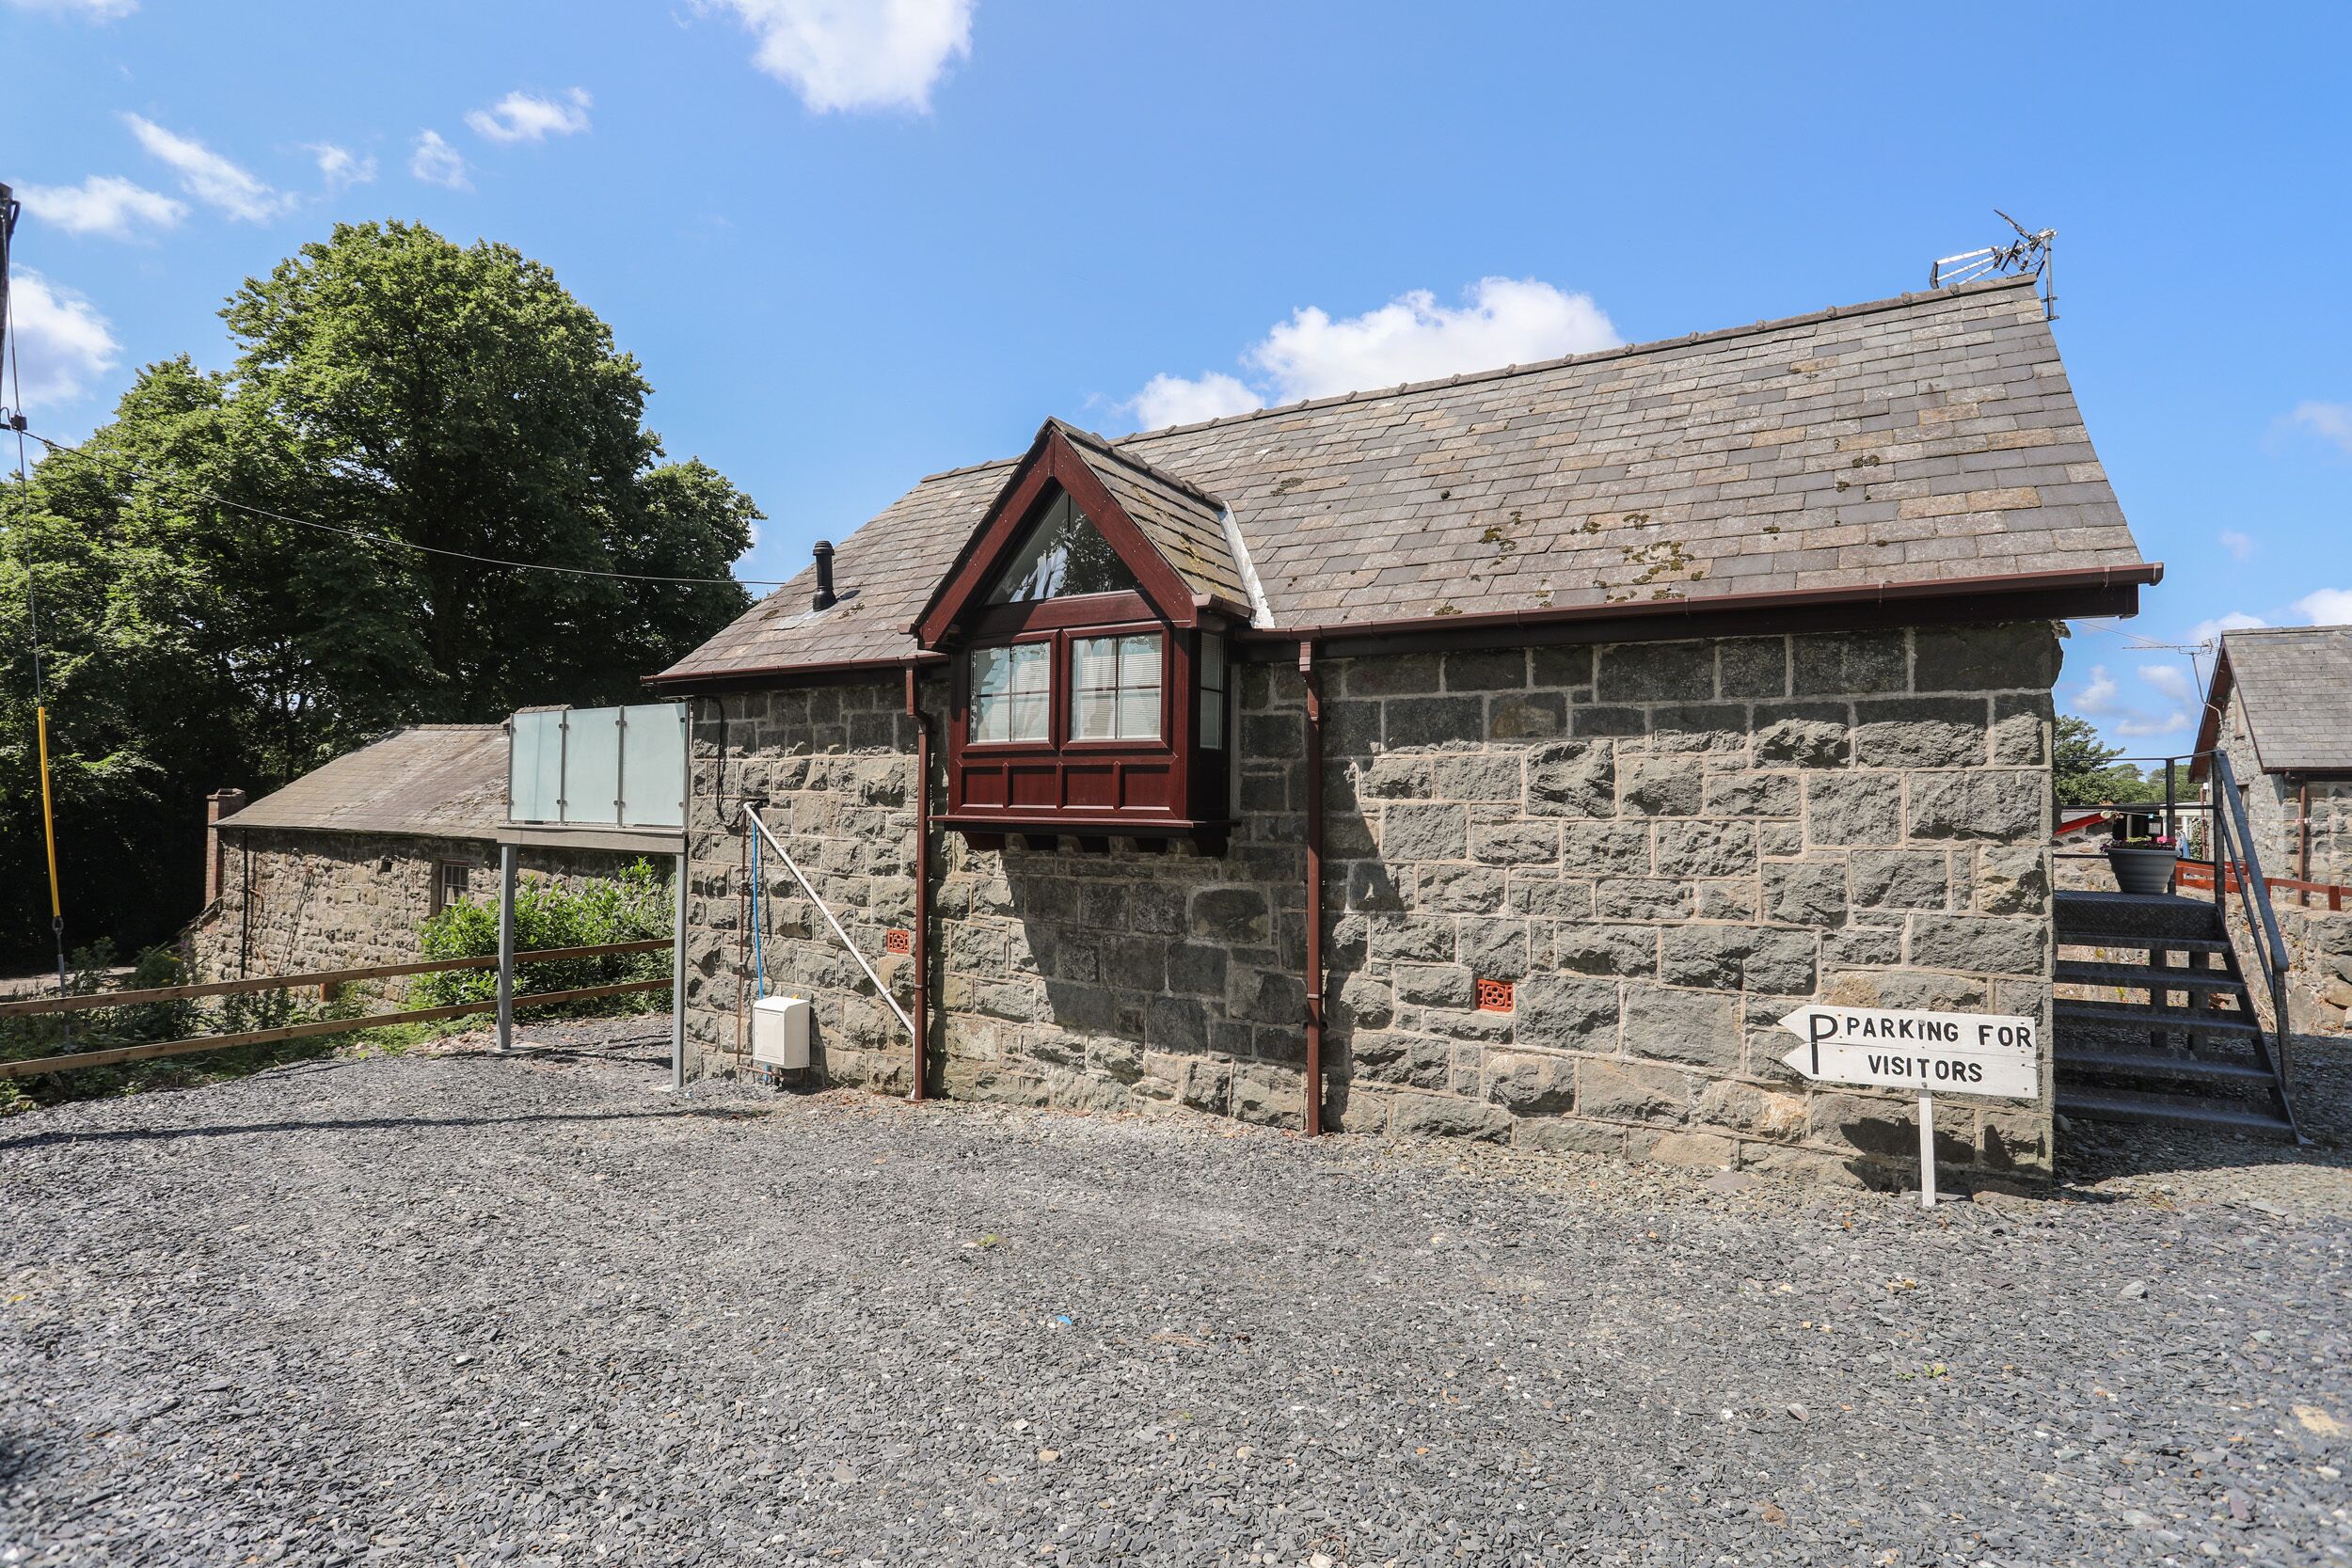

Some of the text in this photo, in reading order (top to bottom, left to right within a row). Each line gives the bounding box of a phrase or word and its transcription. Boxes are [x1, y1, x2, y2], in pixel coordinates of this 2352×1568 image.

[1809, 1014, 1838, 1075] P
[1847, 1017, 2032, 1048] PARKING FOR
[1867, 1054, 1983, 1083] VISITORS
